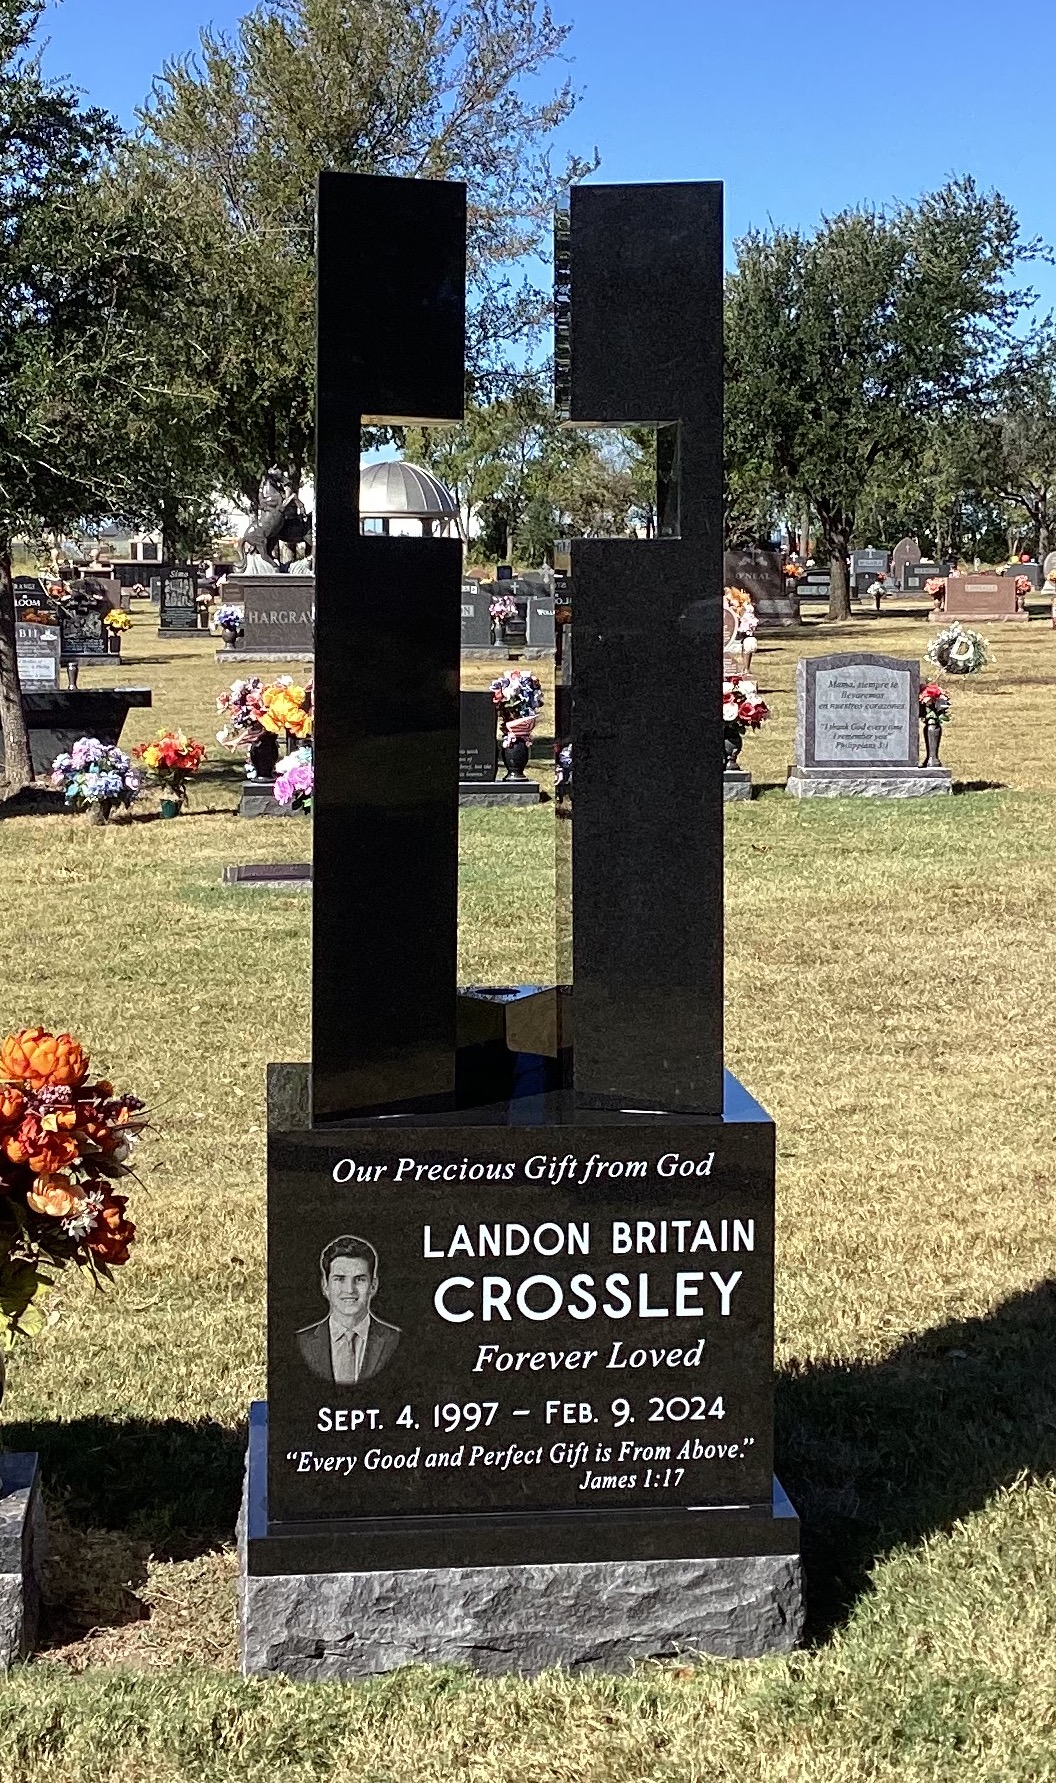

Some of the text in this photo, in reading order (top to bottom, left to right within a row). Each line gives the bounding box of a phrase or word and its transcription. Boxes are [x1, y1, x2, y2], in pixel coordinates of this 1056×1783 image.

[949, 635, 975, 660] D
[851, 723, 866, 731] God
[332, 1151, 715, 1186] Our Precious Gift from God
[423, 1218, 756, 1258] LANDON BRITAIN
[433, 1270, 743, 1323] CROSSLEY
[471, 1338, 706, 1372] Forever Loved
[317, 1407, 384, 1432] SEPT.
[434, 1401, 499, 1433] 1997
[545, 1400, 599, 1425] FEB.
[647, 1395, 726, 1422] 2024
[286, 1451, 358, 1476] “Every
[363, 1446, 422, 1470] Good
[424, 1444, 465, 1468] and
[468, 1443, 543, 1471] Perfect
[549, 1441, 589, 1469] Gift
[595, 1442, 612, 1463] is
[617, 1440, 672, 1462] From
[578, 1467, 685, 1490] James 1:17
